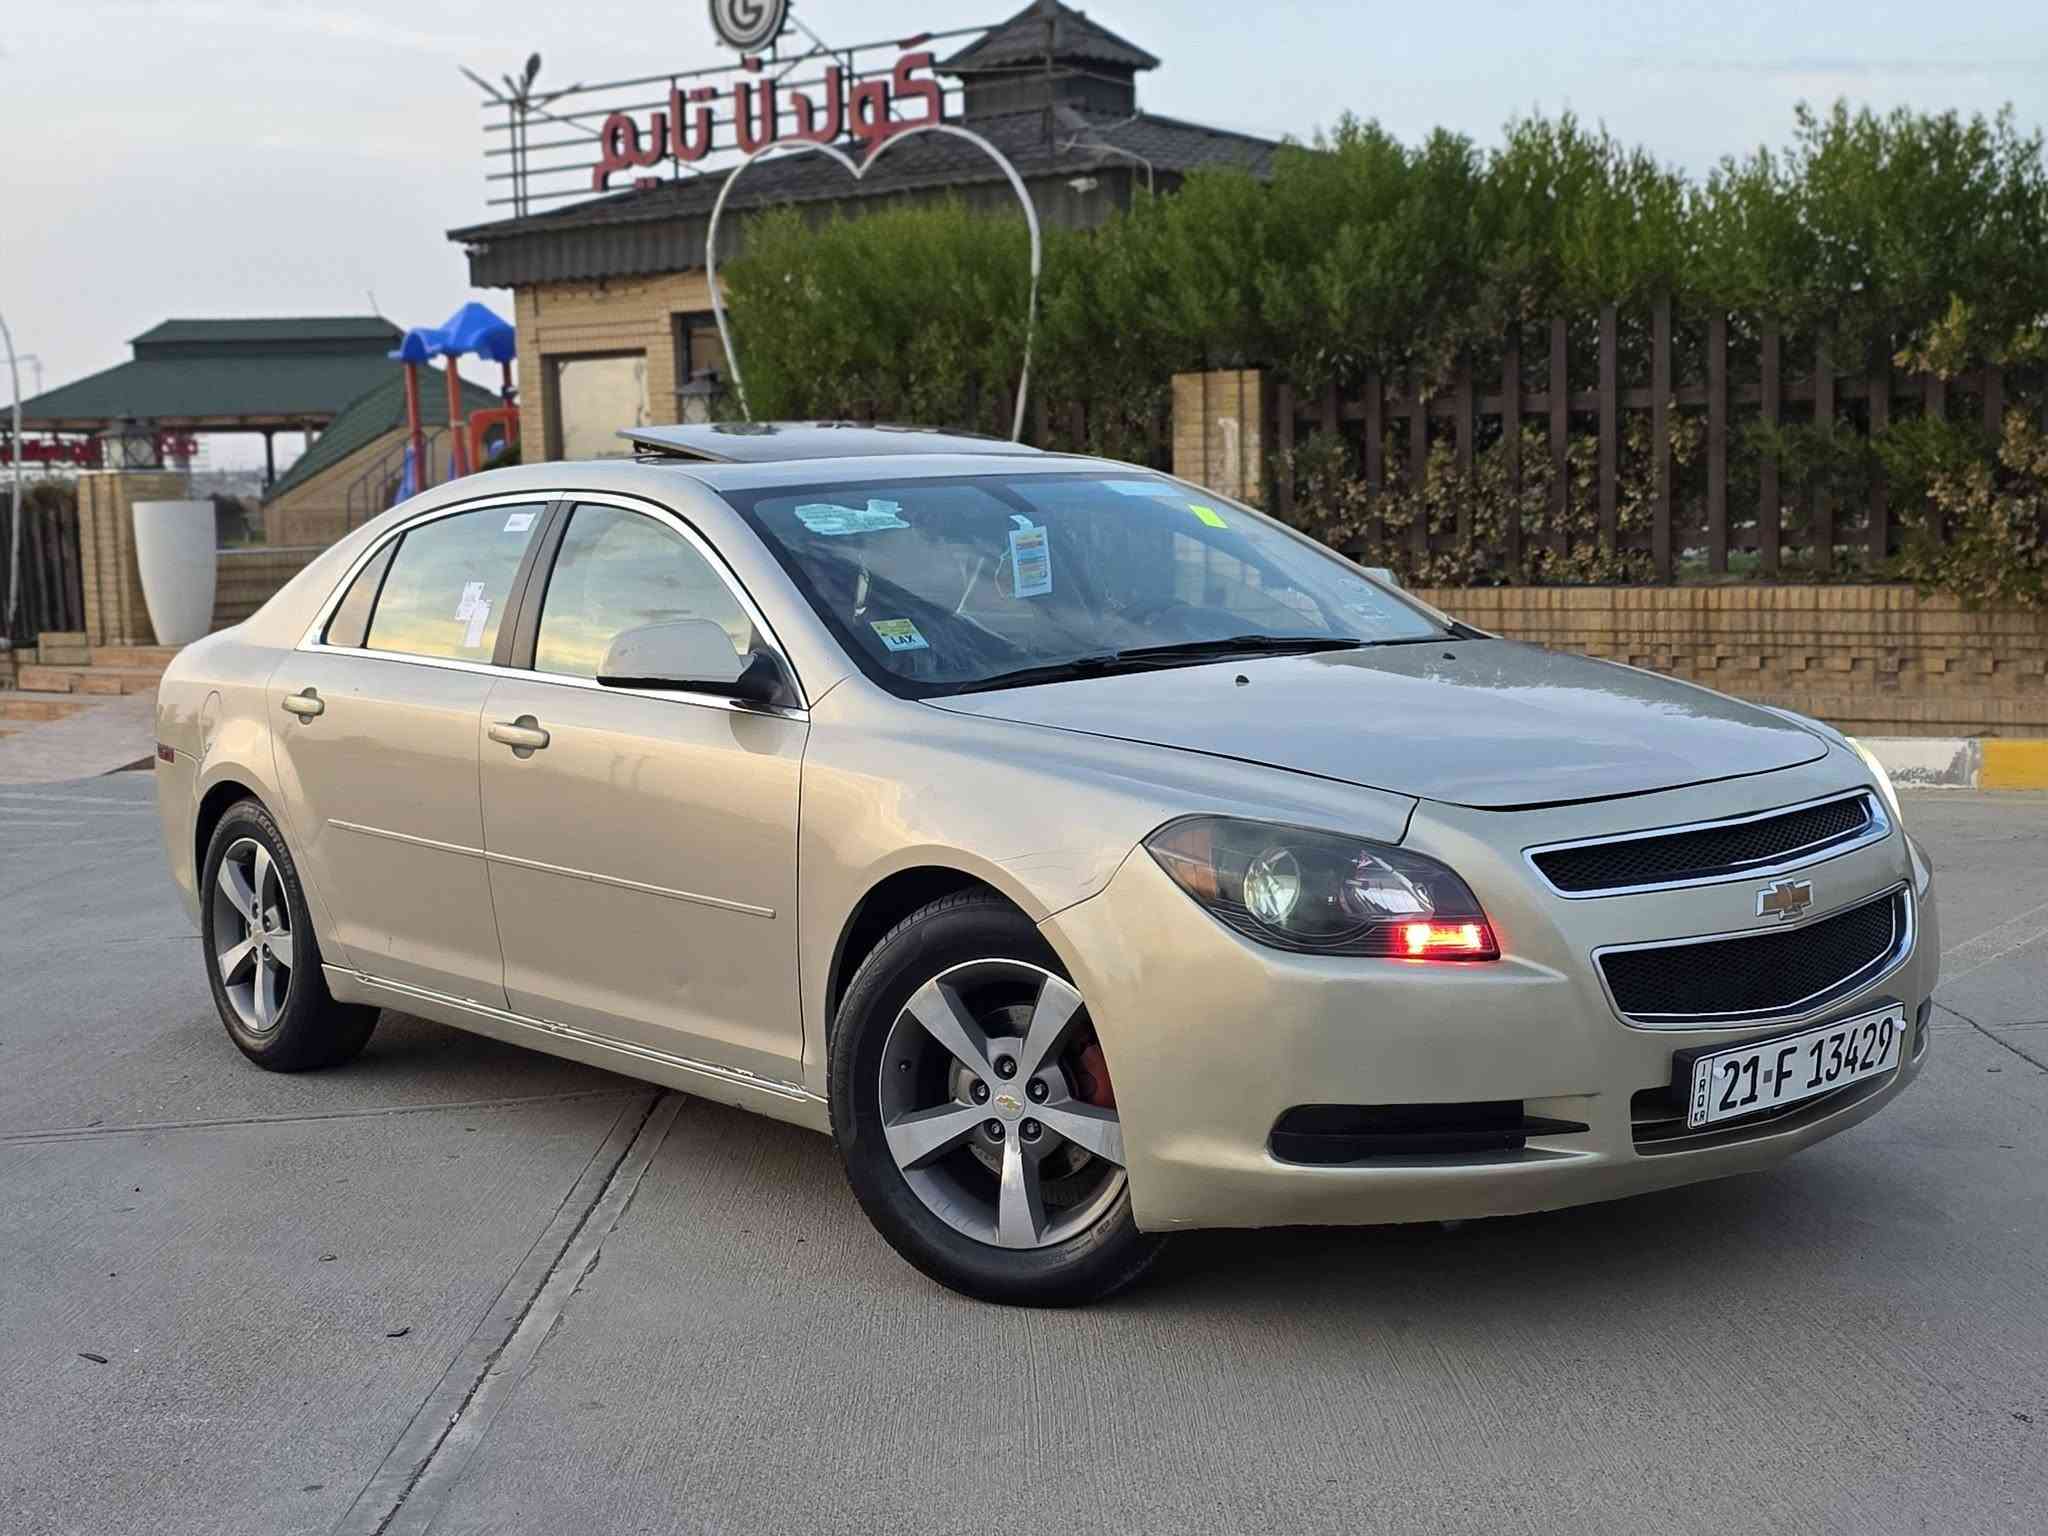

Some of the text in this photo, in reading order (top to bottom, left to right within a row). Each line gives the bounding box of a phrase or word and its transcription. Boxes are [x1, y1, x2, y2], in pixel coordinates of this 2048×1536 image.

[1719, 1017, 1894, 1112] 21 F 13429
